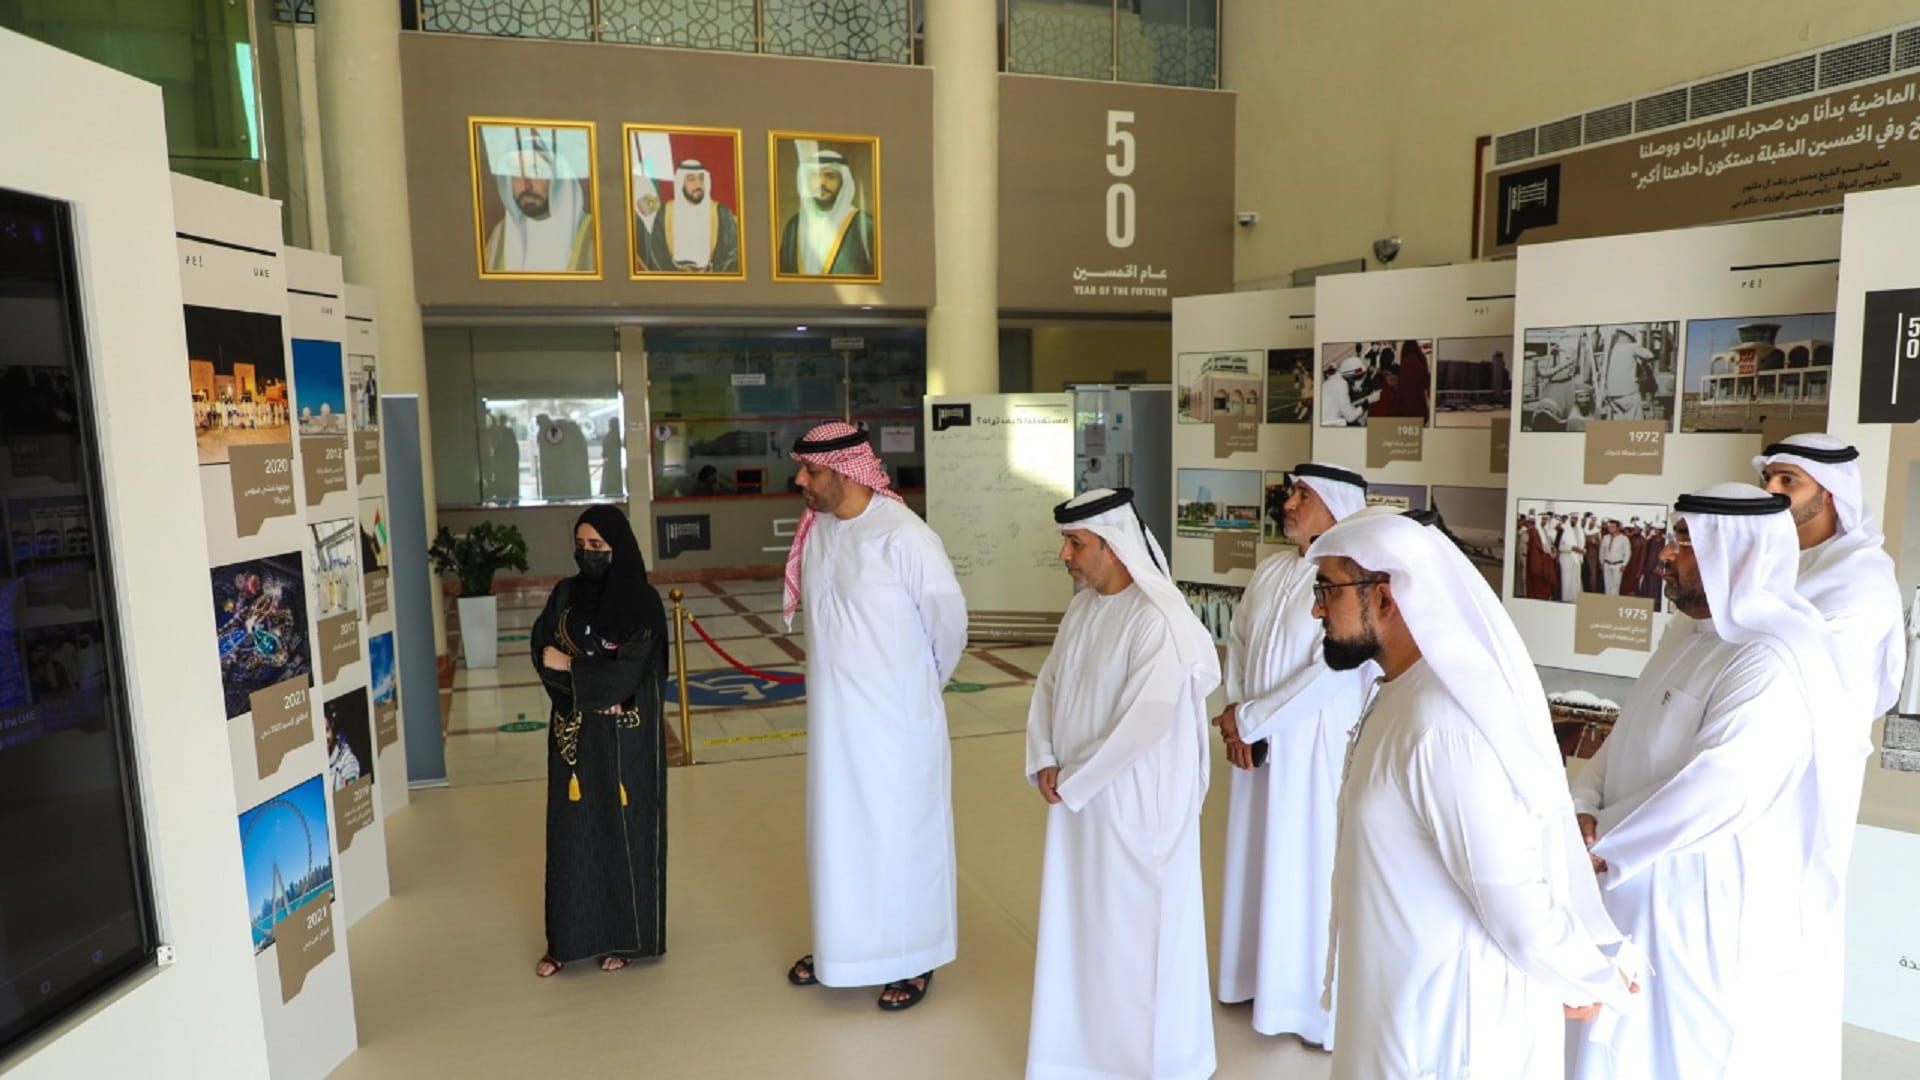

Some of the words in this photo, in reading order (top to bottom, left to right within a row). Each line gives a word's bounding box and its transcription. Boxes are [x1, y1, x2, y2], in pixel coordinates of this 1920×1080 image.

[1813, 97, 1845, 122] بدأنا
[1848, 83, 1916, 117] الماضية
[1736, 118, 1784, 140] صحراء
[1785, 112, 1809, 132] من
[1682, 124, 1735, 150] الإمارات
[1807, 124, 1872, 157] الخمسين
[1875, 117, 1904, 150] وفي
[1640, 142, 1680, 158] ووصلنا
[1757, 138, 1805, 164] المقبلة
[1663, 154, 1703, 180] أحلامنا
[1705, 152, 1754, 176] ستكون
[253, 266, 270, 278] UAE
[1073, 264, 1138, 281] الخمسين
[1140, 264, 1167, 283] عام
[1073, 285, 1096, 296] YEAR
[1099, 286, 1110, 296] OF
[1112, 286, 1128, 296] THE
[1131, 287, 1168, 297] FIFTIETH
[1629, 431, 1659, 442] 1972
[264, 458, 288, 474] 2020
[1618, 607, 1648, 620] 1975
[283, 689, 306, 710] 2021
[306, 904, 327, 930] 2021
